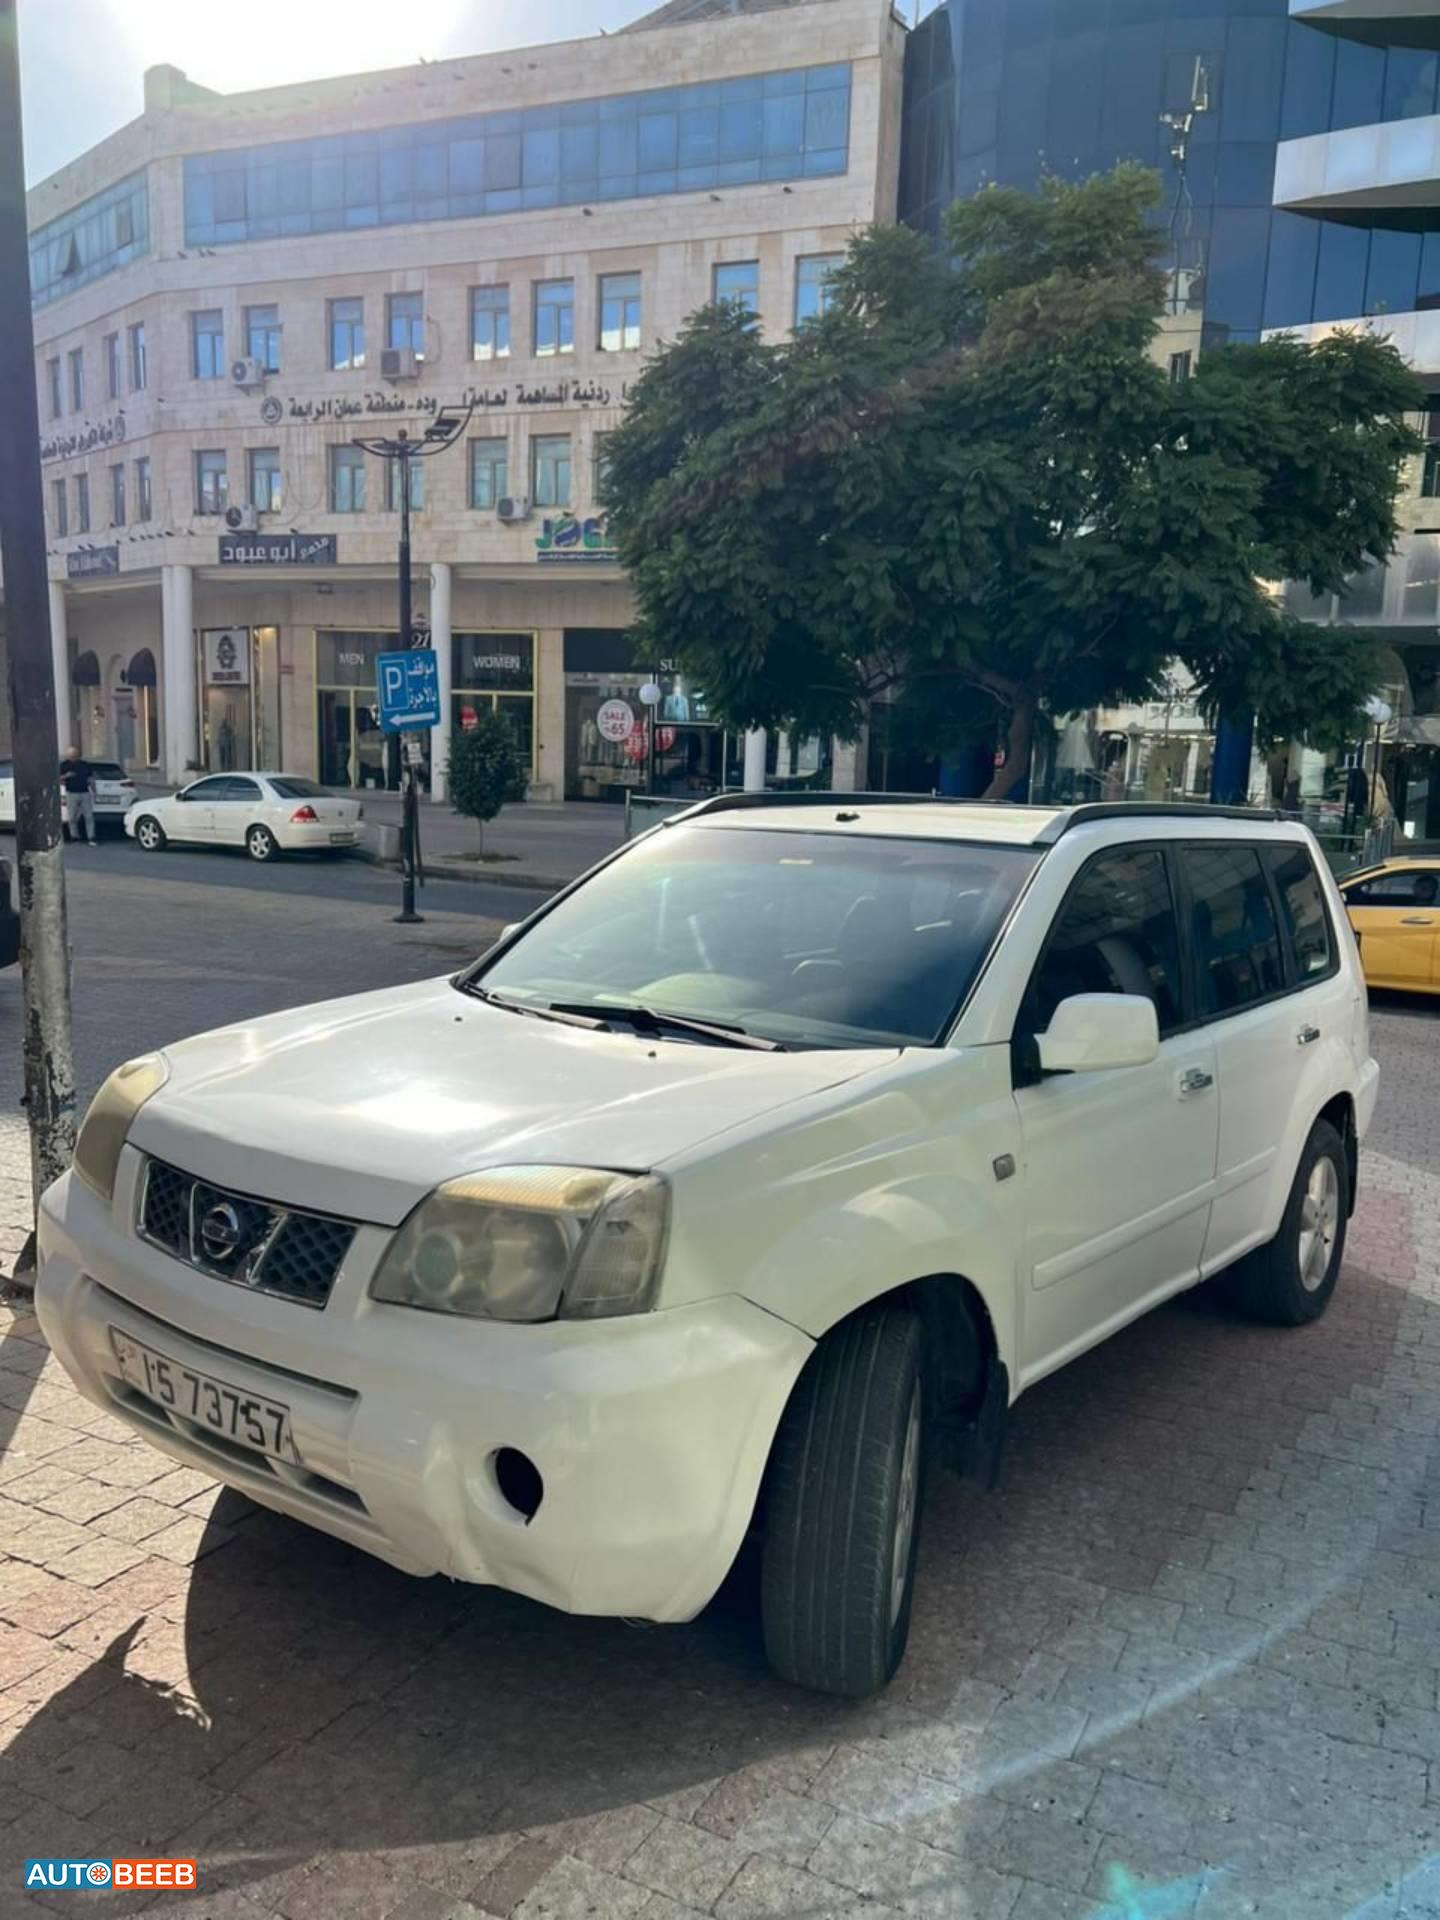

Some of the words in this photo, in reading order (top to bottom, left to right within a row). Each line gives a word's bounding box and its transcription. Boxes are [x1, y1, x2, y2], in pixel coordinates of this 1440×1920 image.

[339, 652, 364, 665] MEN
[407, 656, 435, 680] موقف
[473, 655, 521, 669] WOMEN
[385, 667, 402, 705] P
[183, 1371, 285, 1453] 73757
